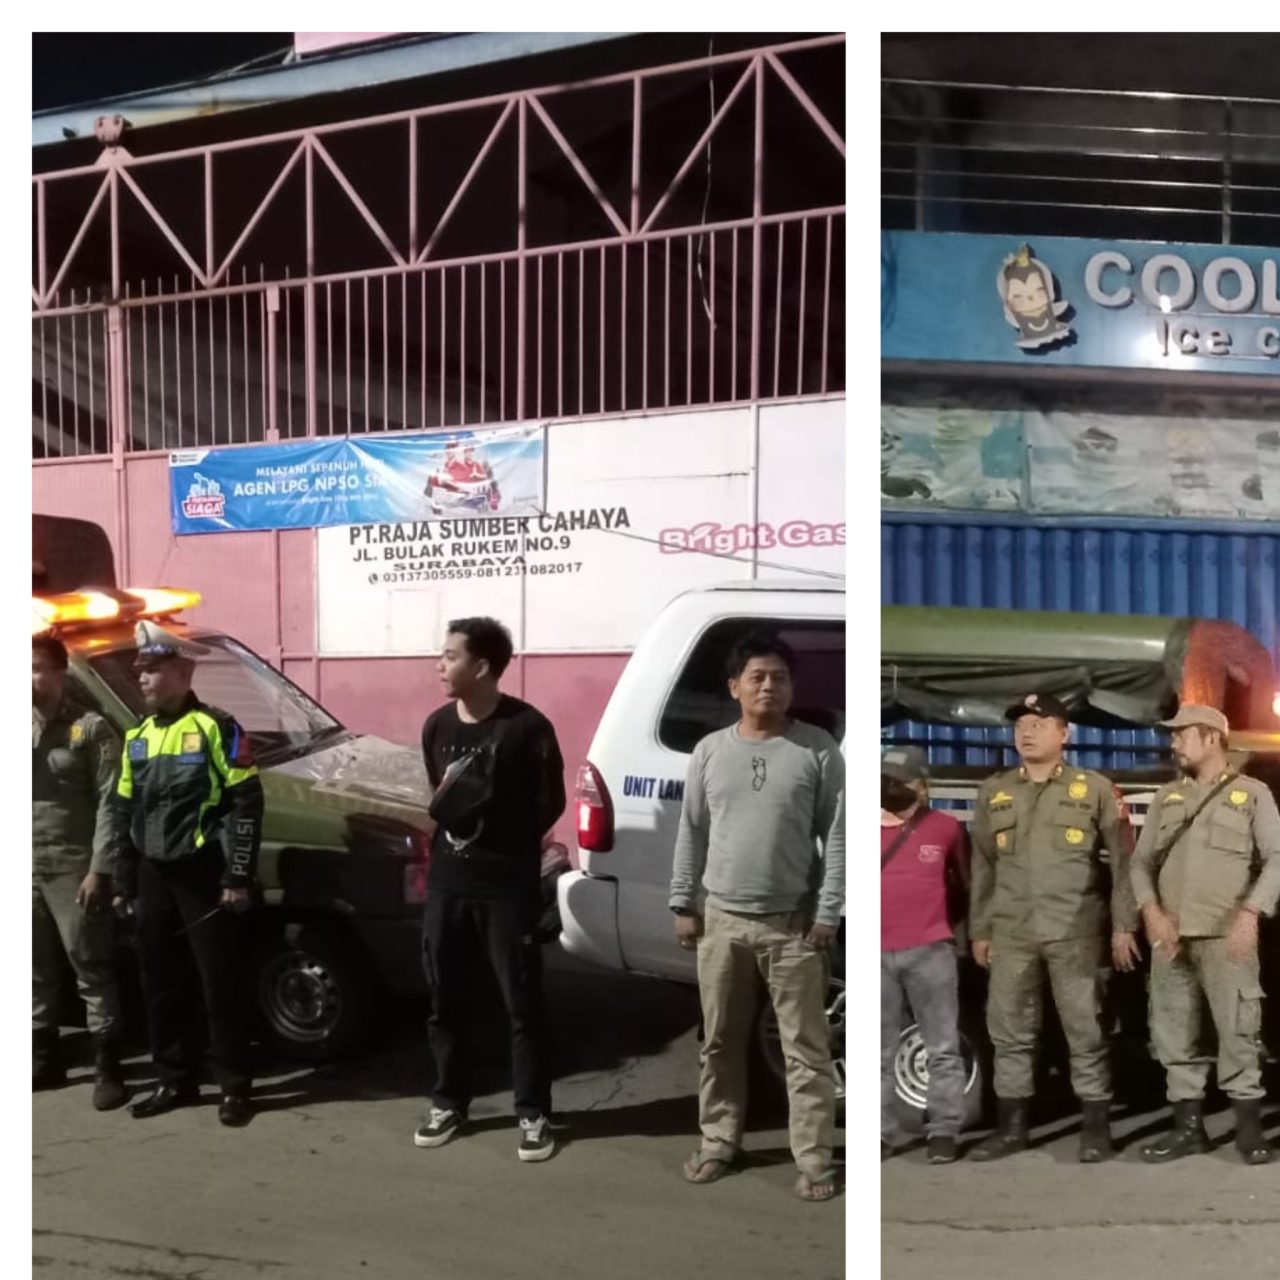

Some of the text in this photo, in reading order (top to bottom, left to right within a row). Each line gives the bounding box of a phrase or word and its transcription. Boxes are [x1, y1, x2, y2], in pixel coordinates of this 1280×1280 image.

[1161, 320, 1231, 357] Ice
[255, 465, 308, 478] MELAYANI
[310, 460, 358, 475] SEPENUH
[233, 481, 277, 497] AGEN
[281, 477, 309, 494] LPG
[314, 474, 360, 492] NPSO
[186, 501, 223, 515] SIAGA
[349, 506, 631, 545] PT.RAJA SUMBER CAHAYA
[659, 519, 846, 555] Bright Gas
[352, 535, 571, 562] JL. BULAK RUKEM NO.9
[393, 555, 527, 572] SURABAYA
[623, 774, 685, 801] UNIT LAN
[231, 818, 255, 876] POLISI
